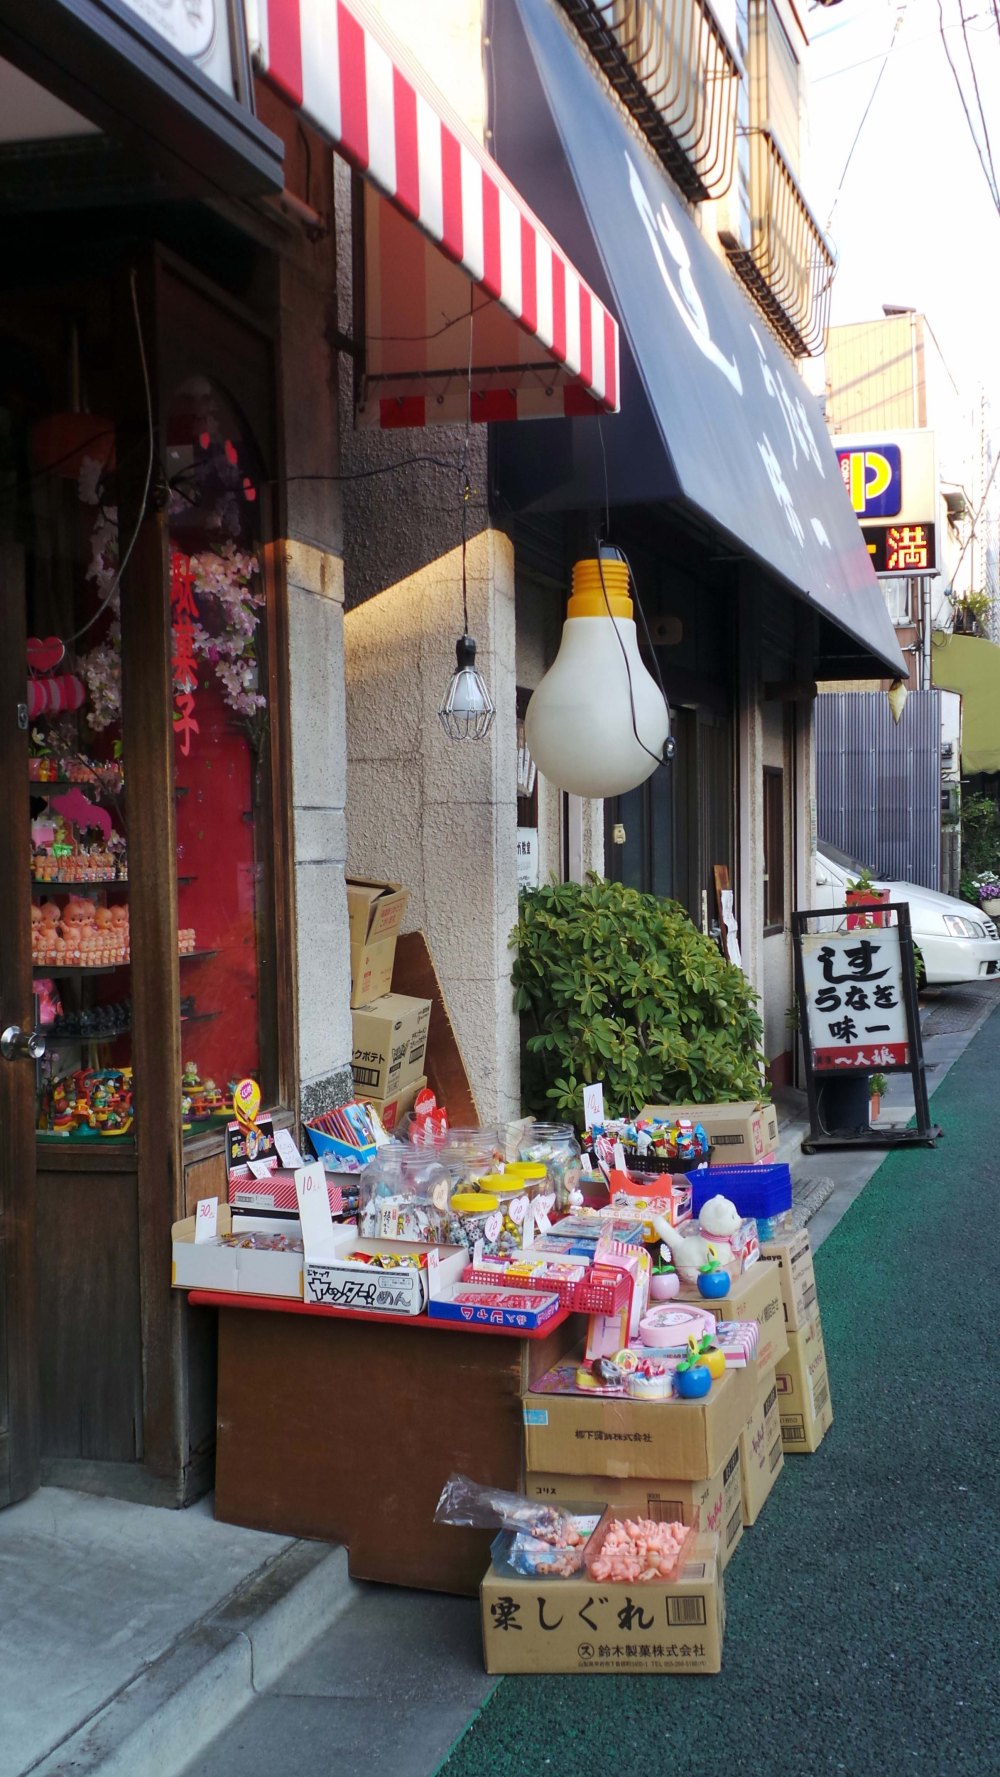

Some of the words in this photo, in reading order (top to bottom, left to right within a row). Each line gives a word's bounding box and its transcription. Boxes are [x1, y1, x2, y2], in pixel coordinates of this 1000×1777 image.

[887, 526, 927, 569] 満
[814, 984, 899, 1012] うなぎ
[828, 1015, 891, 1044] 味一
[598, 1643, 706, 1658] 鈴木製菓株式会社
